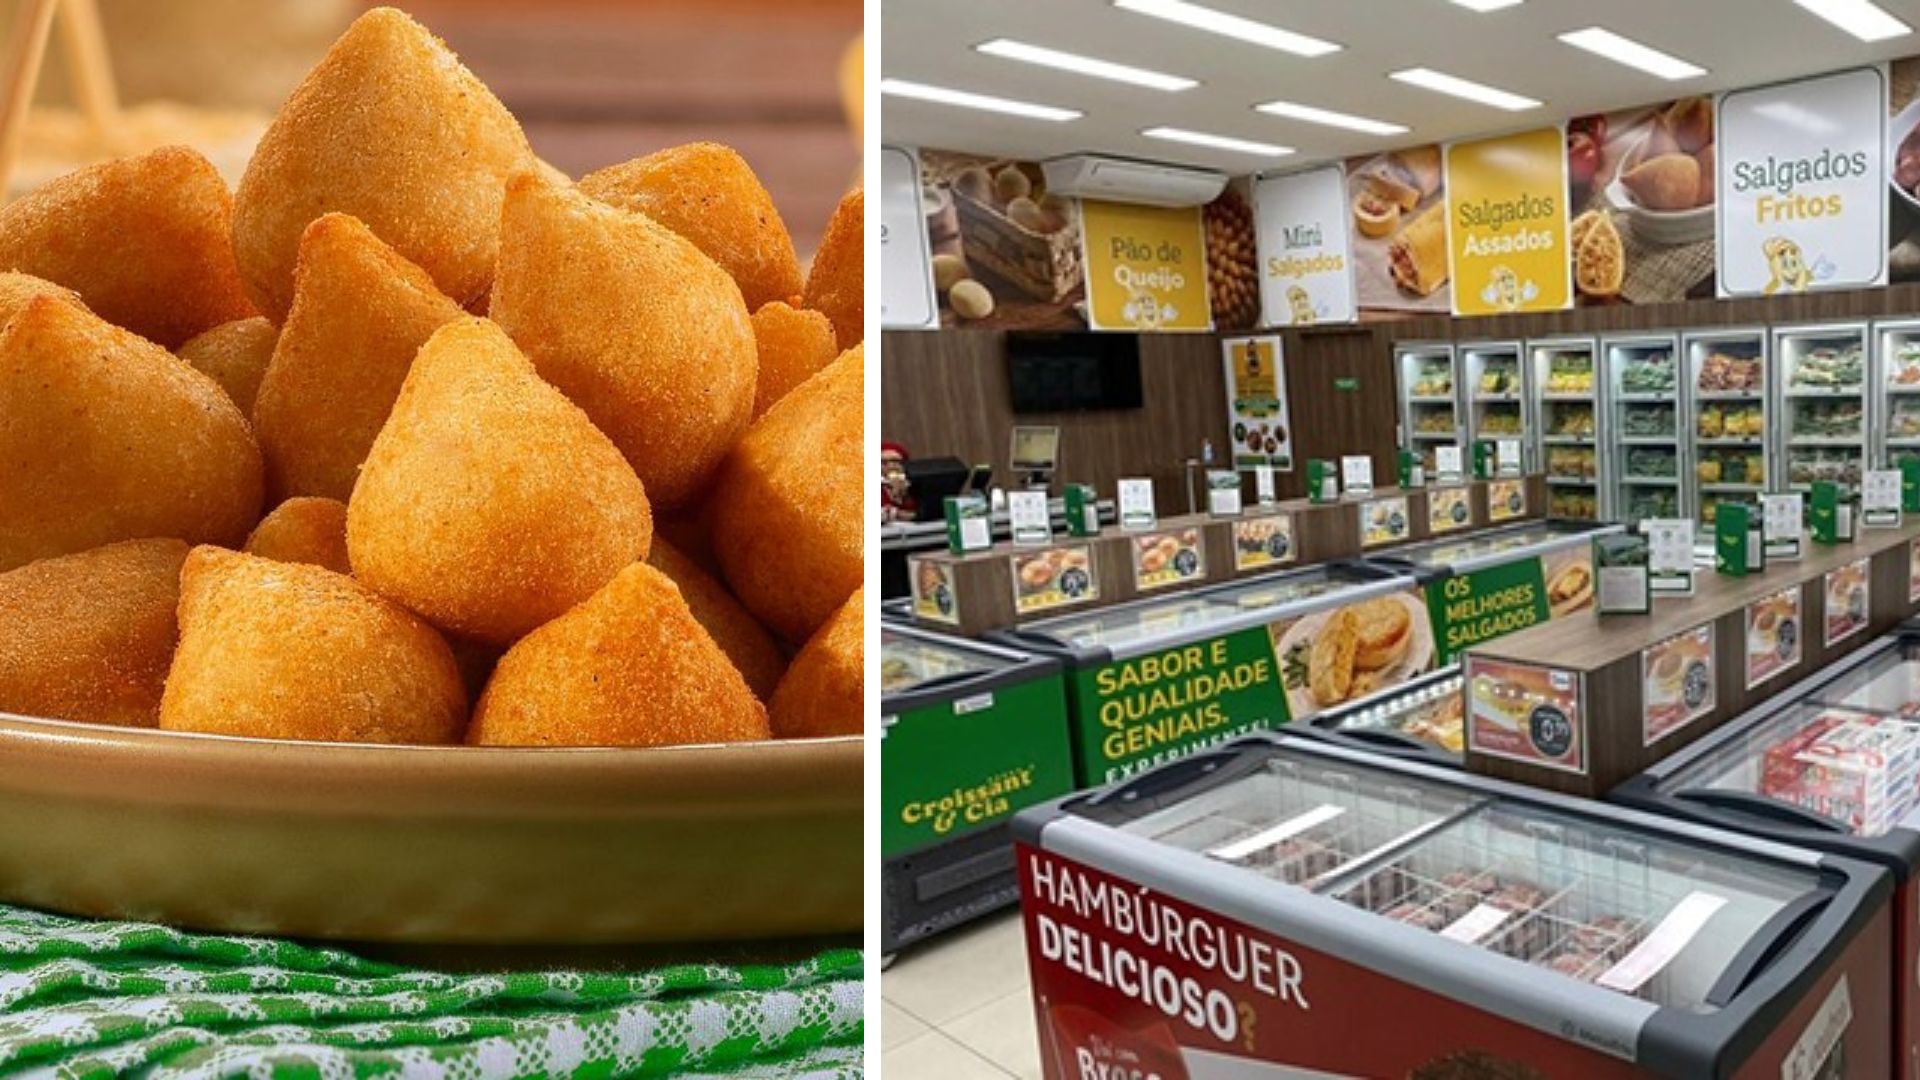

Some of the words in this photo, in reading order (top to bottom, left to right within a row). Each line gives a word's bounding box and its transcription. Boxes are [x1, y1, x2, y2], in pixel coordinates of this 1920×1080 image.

[1733, 147, 1867, 194] Salgados
[1459, 192, 1553, 231] Salgados
[1756, 193, 1842, 223] Fritos
[1111, 236, 1151, 261] Pão
[1156, 240, 1182, 264] de
[1283, 222, 1322, 249] Mini
[1463, 227, 1553, 256] Assados
[1114, 264, 1185, 292] Queijo
[1267, 252, 1344, 279] Salgados
[1444, 575, 1470, 599] OS
[1446, 583, 1535, 624] MELHORES
[1447, 604, 1536, 648] SALGADOS
[1096, 647, 1203, 695] SABOR
[1210, 639, 1227, 665] E
[1101, 658, 1269, 729] QUALIDADE
[1103, 702, 1229, 759] GENIAIS.
[901, 769, 1032, 823] Croissant
[965, 797, 1009, 822] Cia
[1031, 855, 1309, 1009] HAMBÚRGUER
